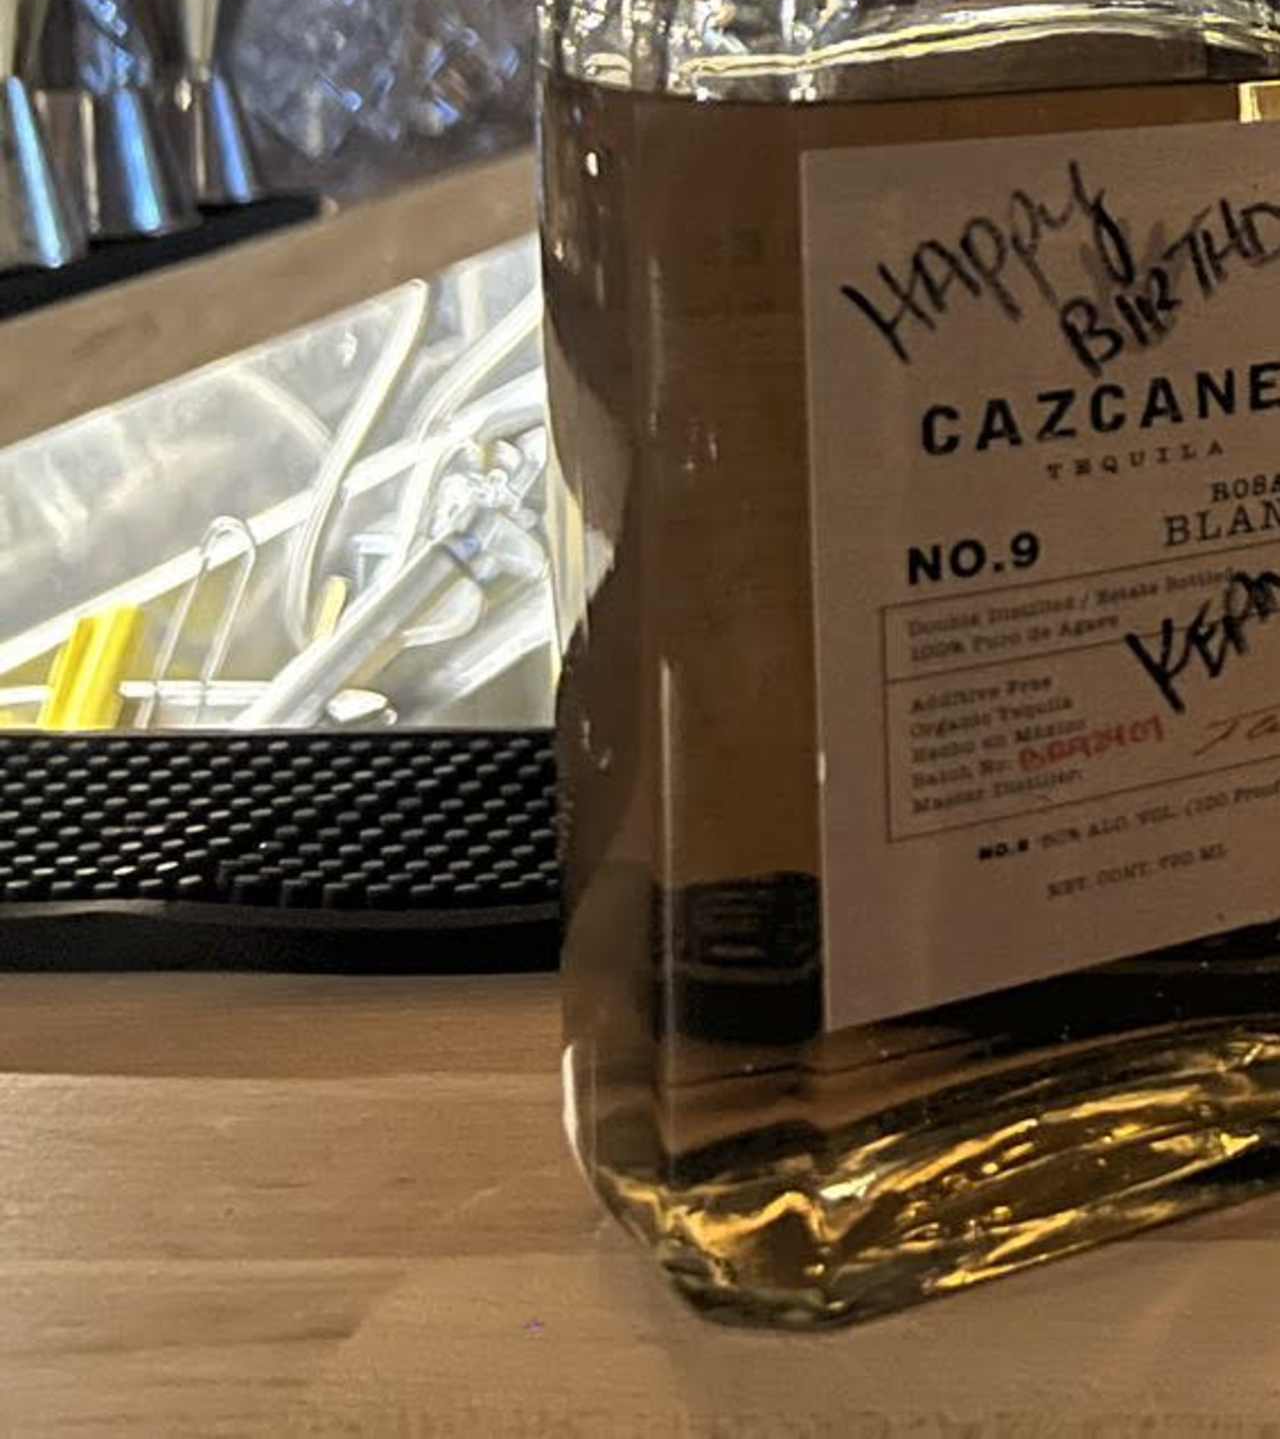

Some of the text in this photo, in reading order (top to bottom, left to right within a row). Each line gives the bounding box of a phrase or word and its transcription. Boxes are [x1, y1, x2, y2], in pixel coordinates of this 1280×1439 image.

[1046, 439, 1225, 480] TEQUILA
[906, 530, 1041, 587] NO.9
[1098, 581, 1159, 606] Estate
[1057, 613, 1121, 639] Agave
[999, 695, 1074, 721] Tequila
